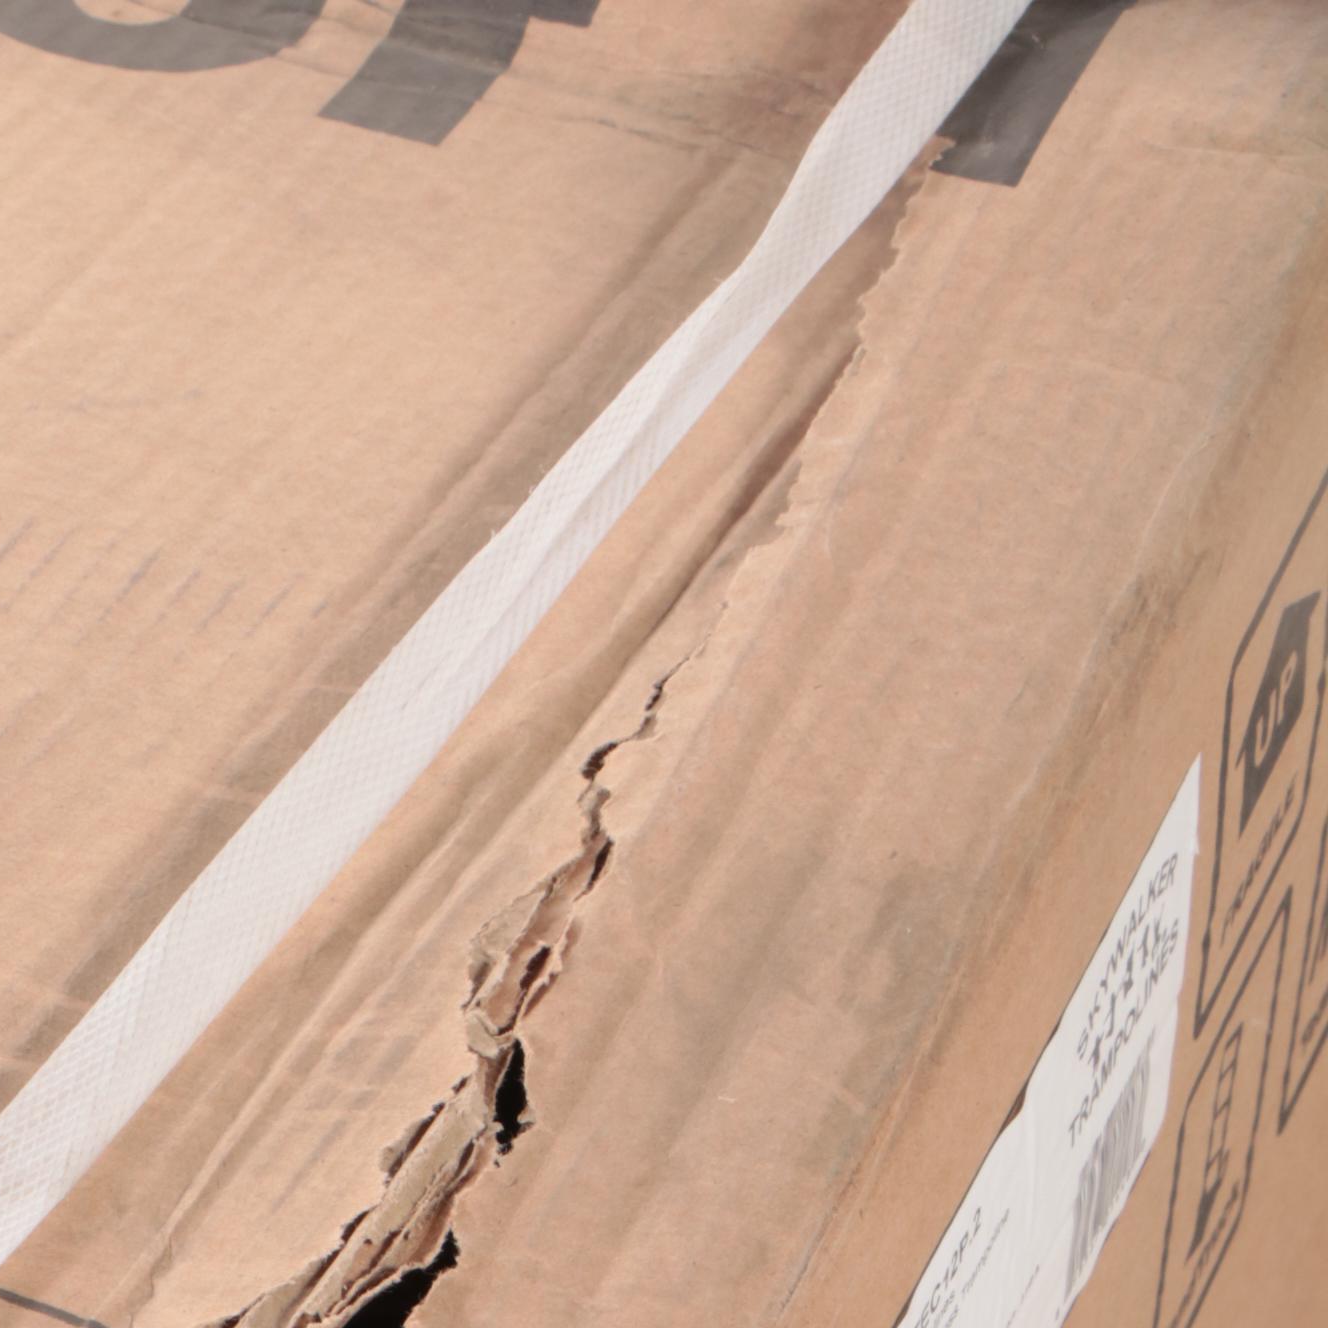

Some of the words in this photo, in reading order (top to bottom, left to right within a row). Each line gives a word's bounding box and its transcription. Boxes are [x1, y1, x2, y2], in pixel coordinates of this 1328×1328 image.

[1254, 650, 1298, 768] UP
[1069, 919, 1179, 1147] TRAMPOLINES
[1077, 853, 1178, 1057] SKYWALKER
